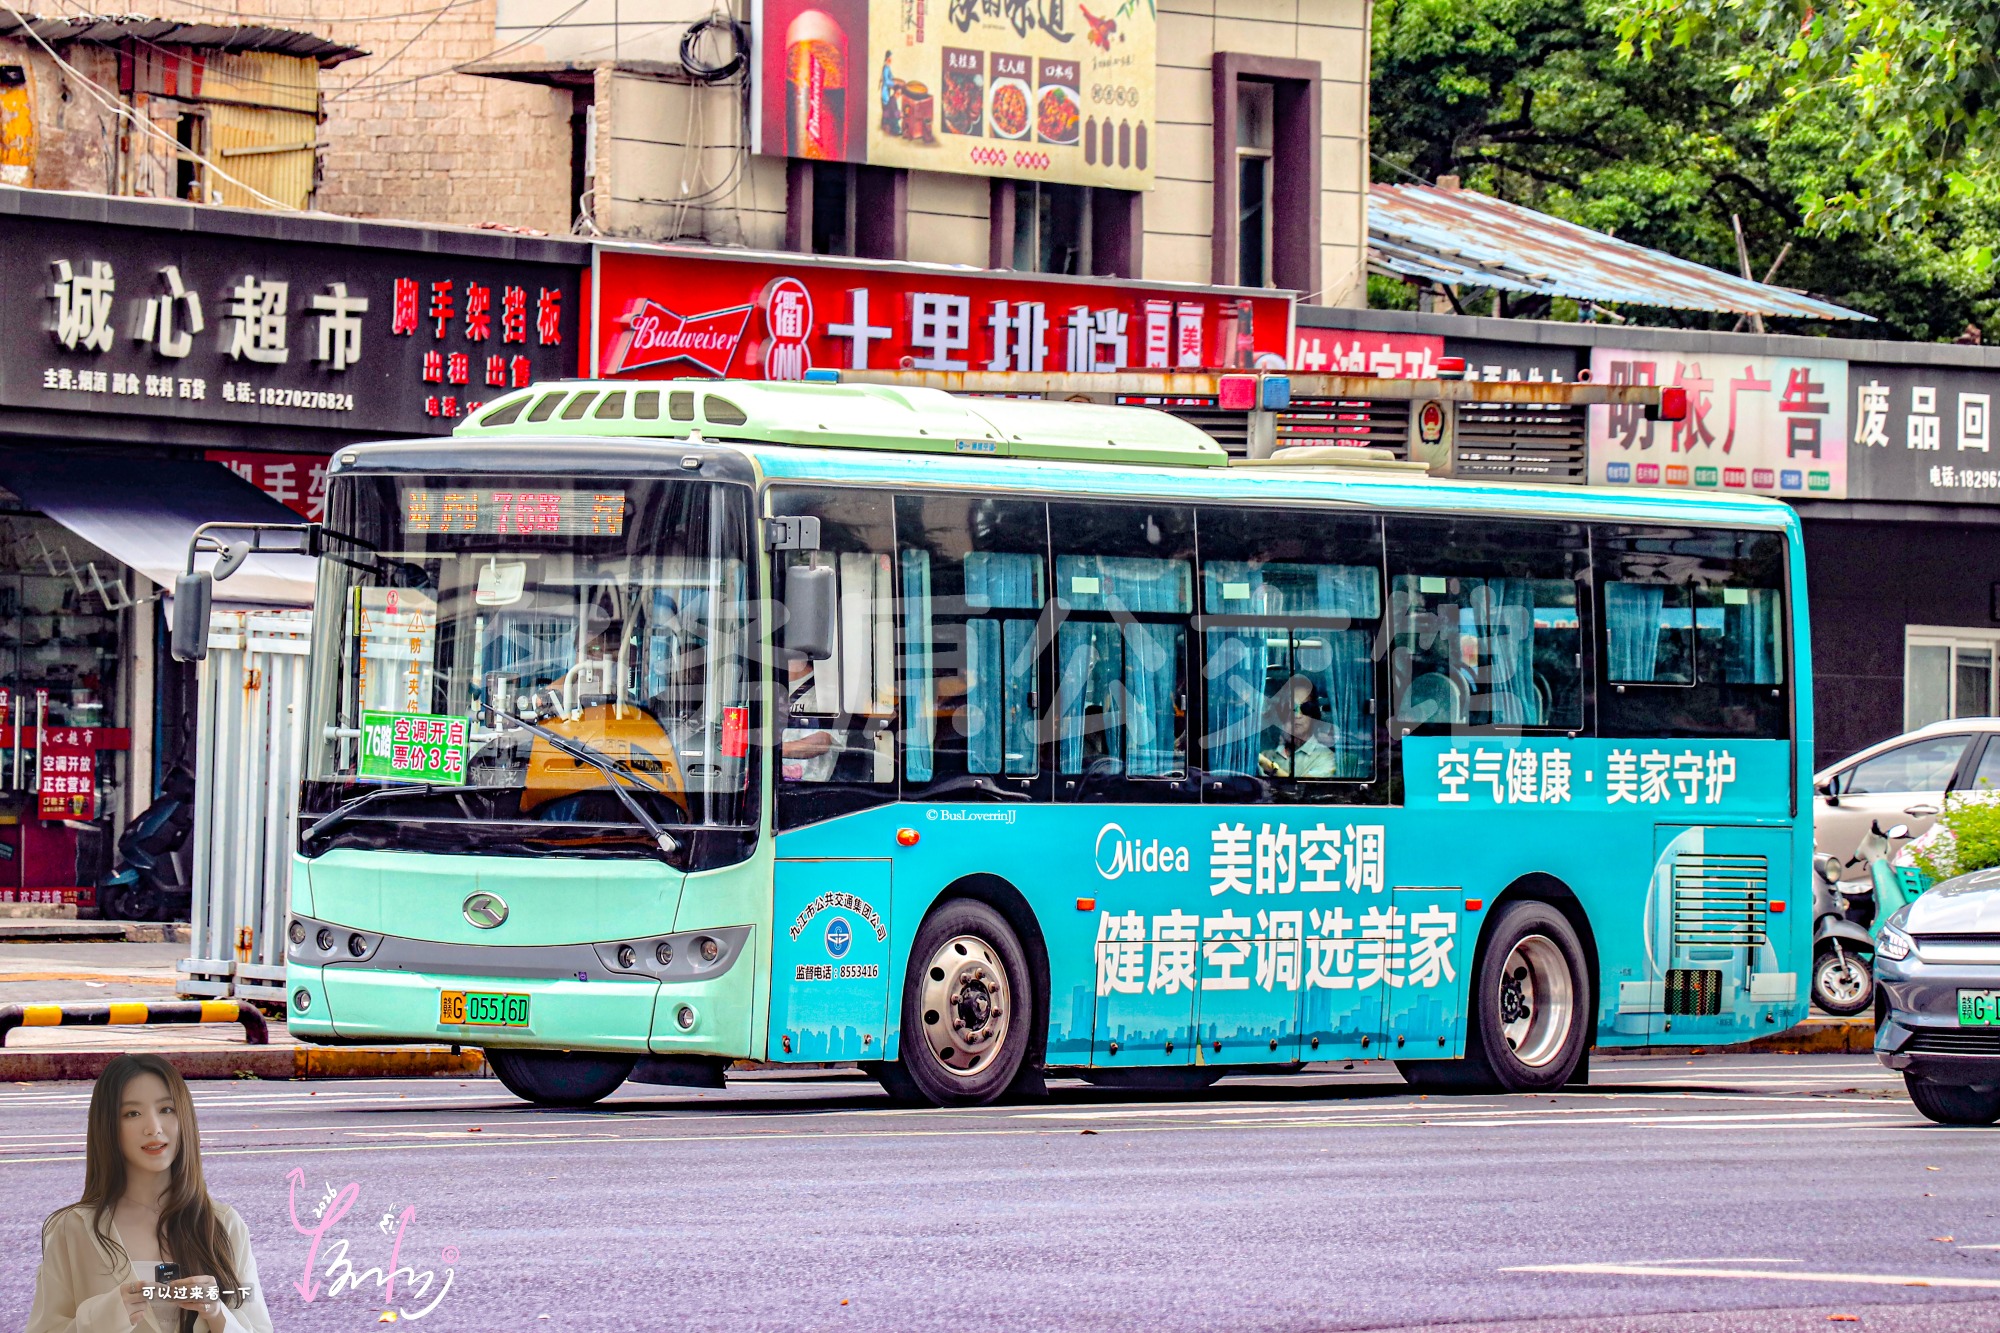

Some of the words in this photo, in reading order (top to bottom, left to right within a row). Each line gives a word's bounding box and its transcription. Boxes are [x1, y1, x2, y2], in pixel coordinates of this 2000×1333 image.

[49, 258, 369, 371] 诚心超市
[391, 276, 563, 346] 脚手架挡板
[630, 314, 740, 352] Budweiser
[827, 287, 1129, 373] 十里排档
[146, 374, 173, 398] 饮料
[178, 377, 206, 401] 百货
[423, 350, 470, 384] 出租
[485, 354, 531, 388] 出售
[1607, 359, 1830, 459] 明依广告
[1854, 379, 1991, 453] 废品回
[406, 636, 421, 713] 防止夹伤
[365, 724, 392, 758] 76路
[394, 719, 464, 747] 空调开启
[43, 755, 91, 772] 空调开放
[391, 745, 462, 773] 票价3元
[43, 776, 91, 793] 正在营业
[1096, 828, 1190, 878] Midea
[1209, 822, 1386, 896] 美的空调
[20, 890, 62, 904] 欢迎光临
[789, 891, 888, 942] 九江市公共交通集团公司
[1095, 904, 1458, 998] 健康空调选美家
